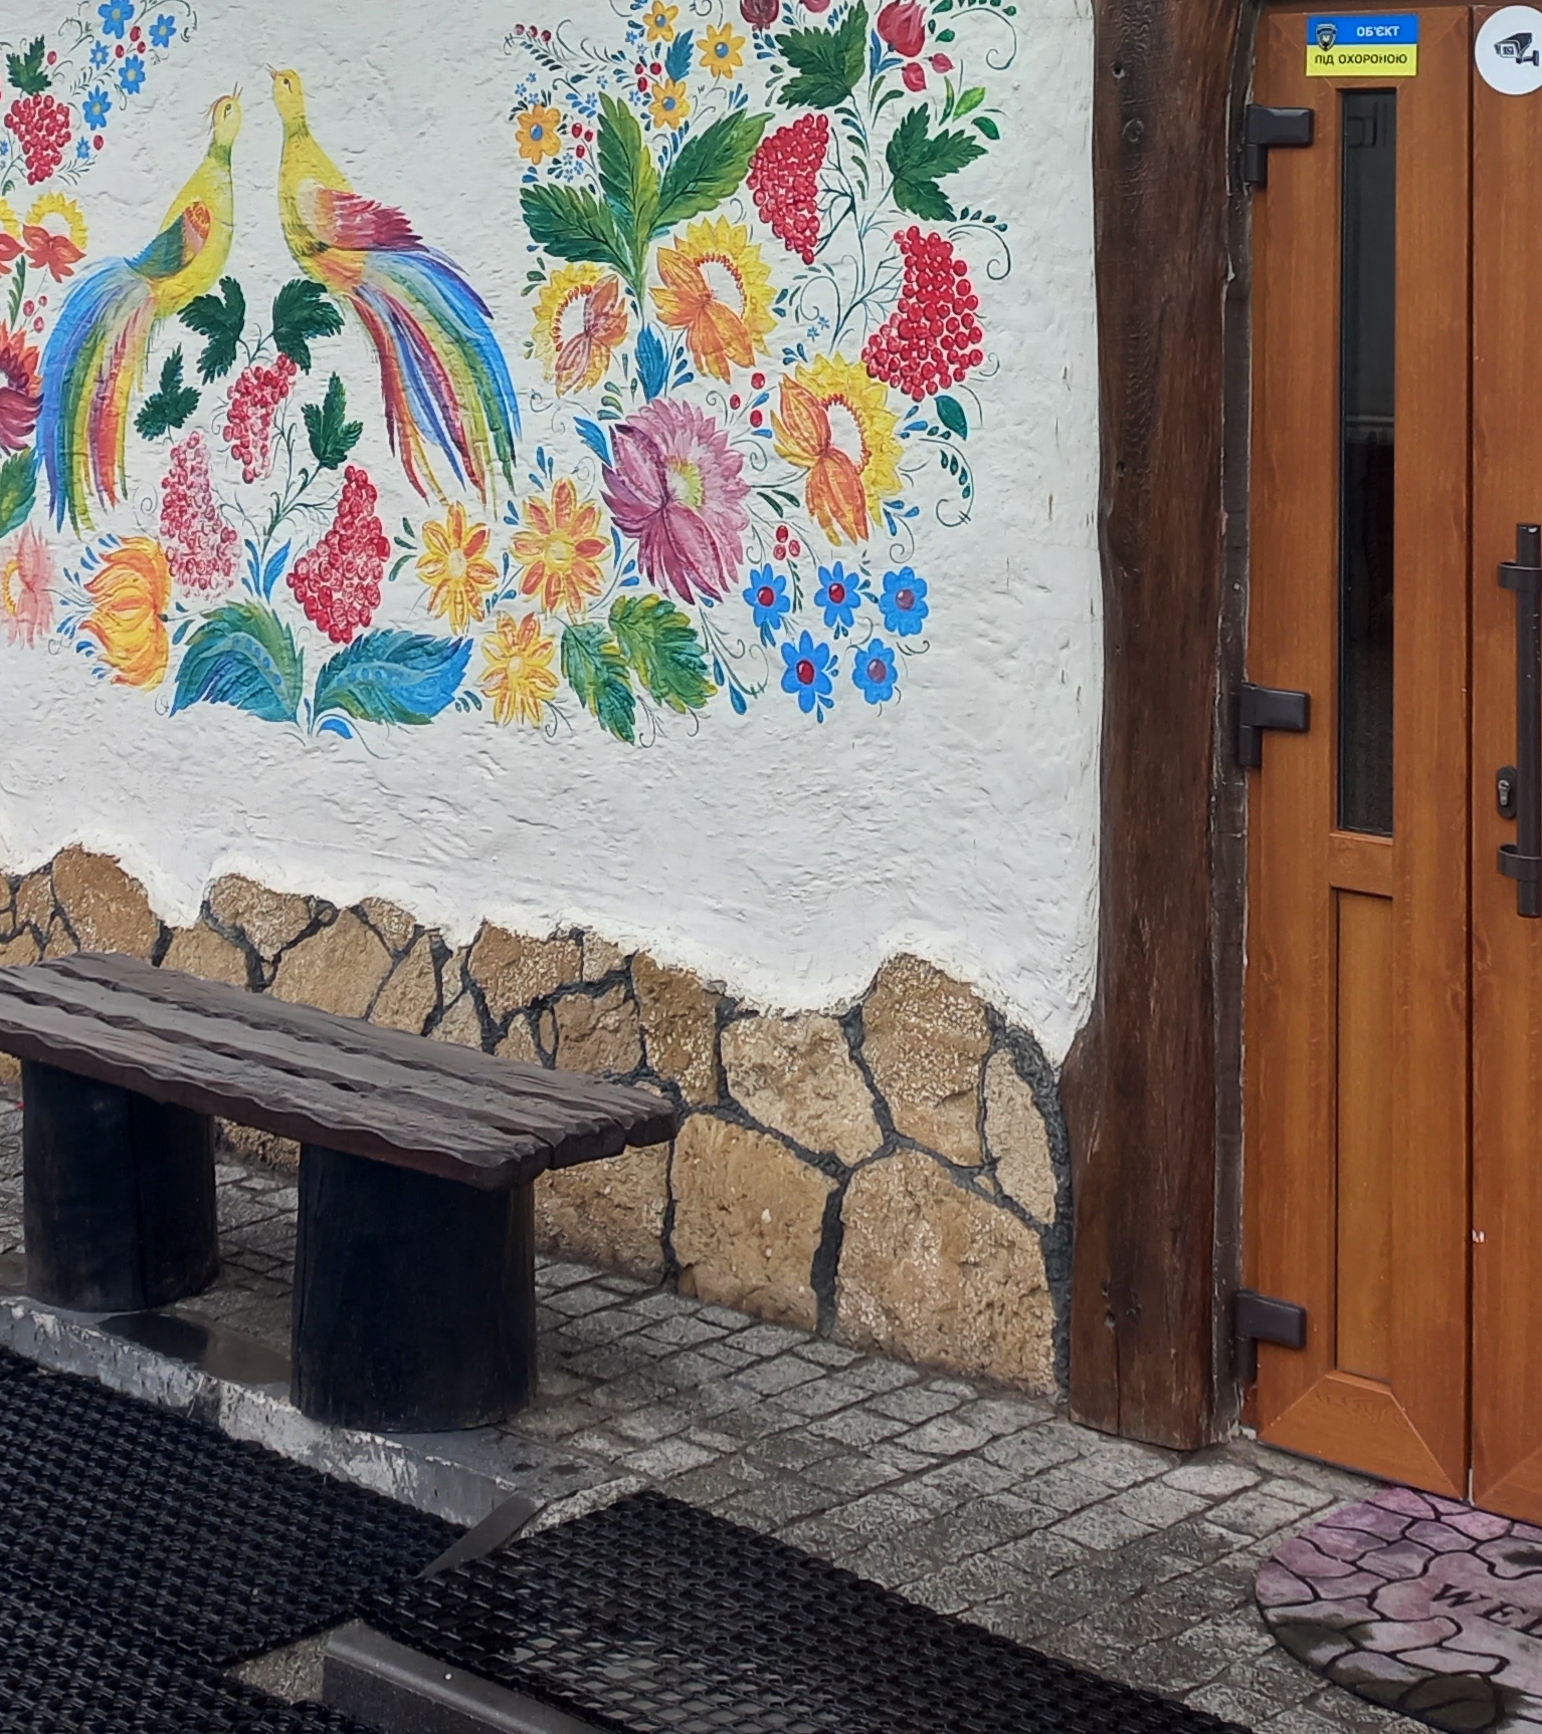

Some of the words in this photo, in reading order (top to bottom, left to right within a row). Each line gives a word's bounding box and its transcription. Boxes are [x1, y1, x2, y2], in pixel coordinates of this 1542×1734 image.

[1356, 25, 1400, 37] ОБ'ЄКТ
[1314, 54, 1334, 66] ПІД
[1338, 53, 1408, 64] ОХОРОНОЮ
